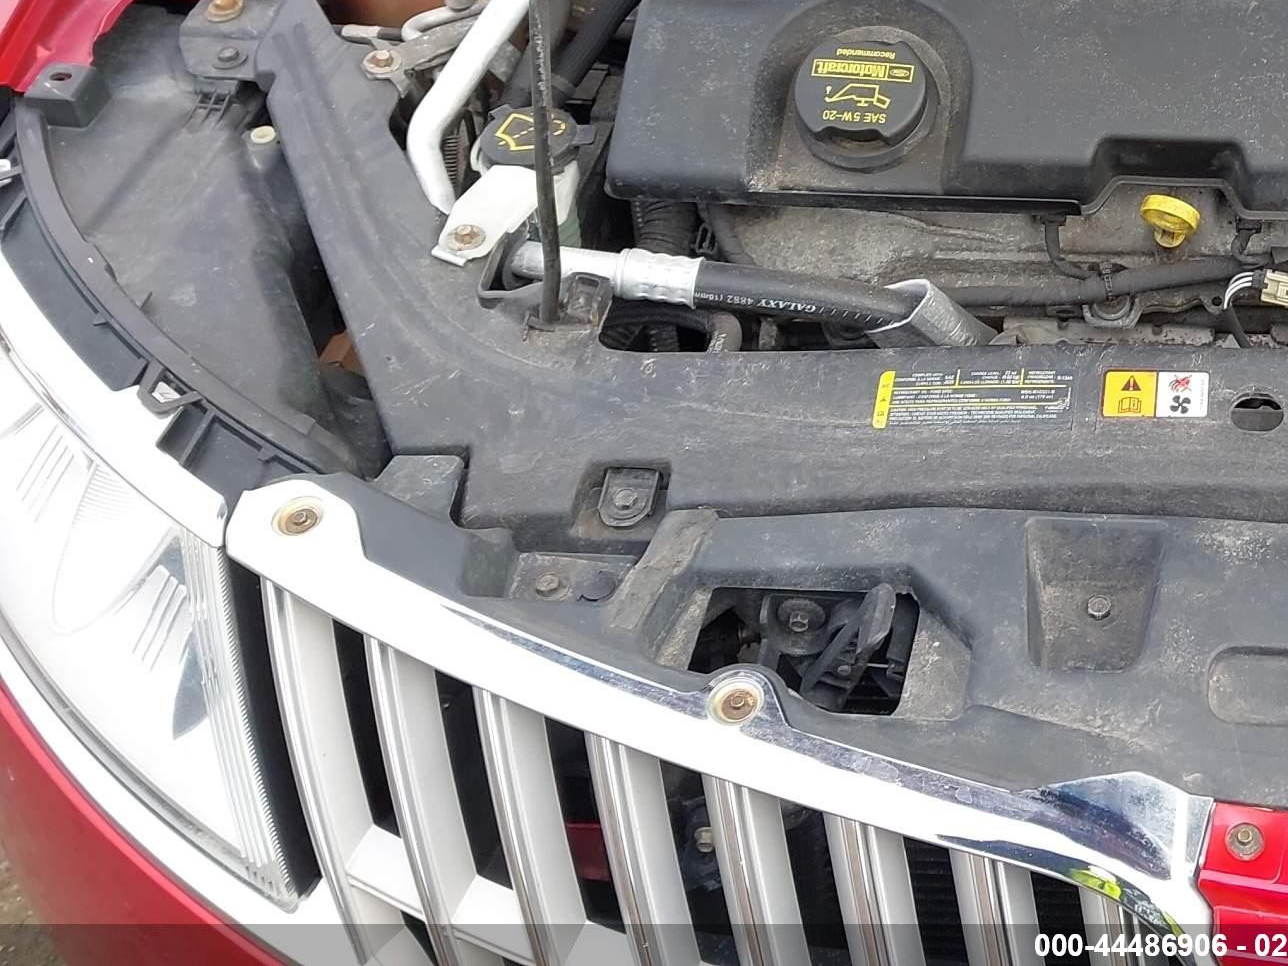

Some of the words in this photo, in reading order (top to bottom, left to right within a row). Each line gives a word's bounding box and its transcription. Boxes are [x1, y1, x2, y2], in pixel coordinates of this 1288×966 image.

[836, 48, 896, 60] Recommended
[816, 61, 886, 78] Motorcraft
[822, 110, 861, 122] 5W-20
[863, 112, 886, 124] SAE
[757, 298, 816, 313] GALAXY
